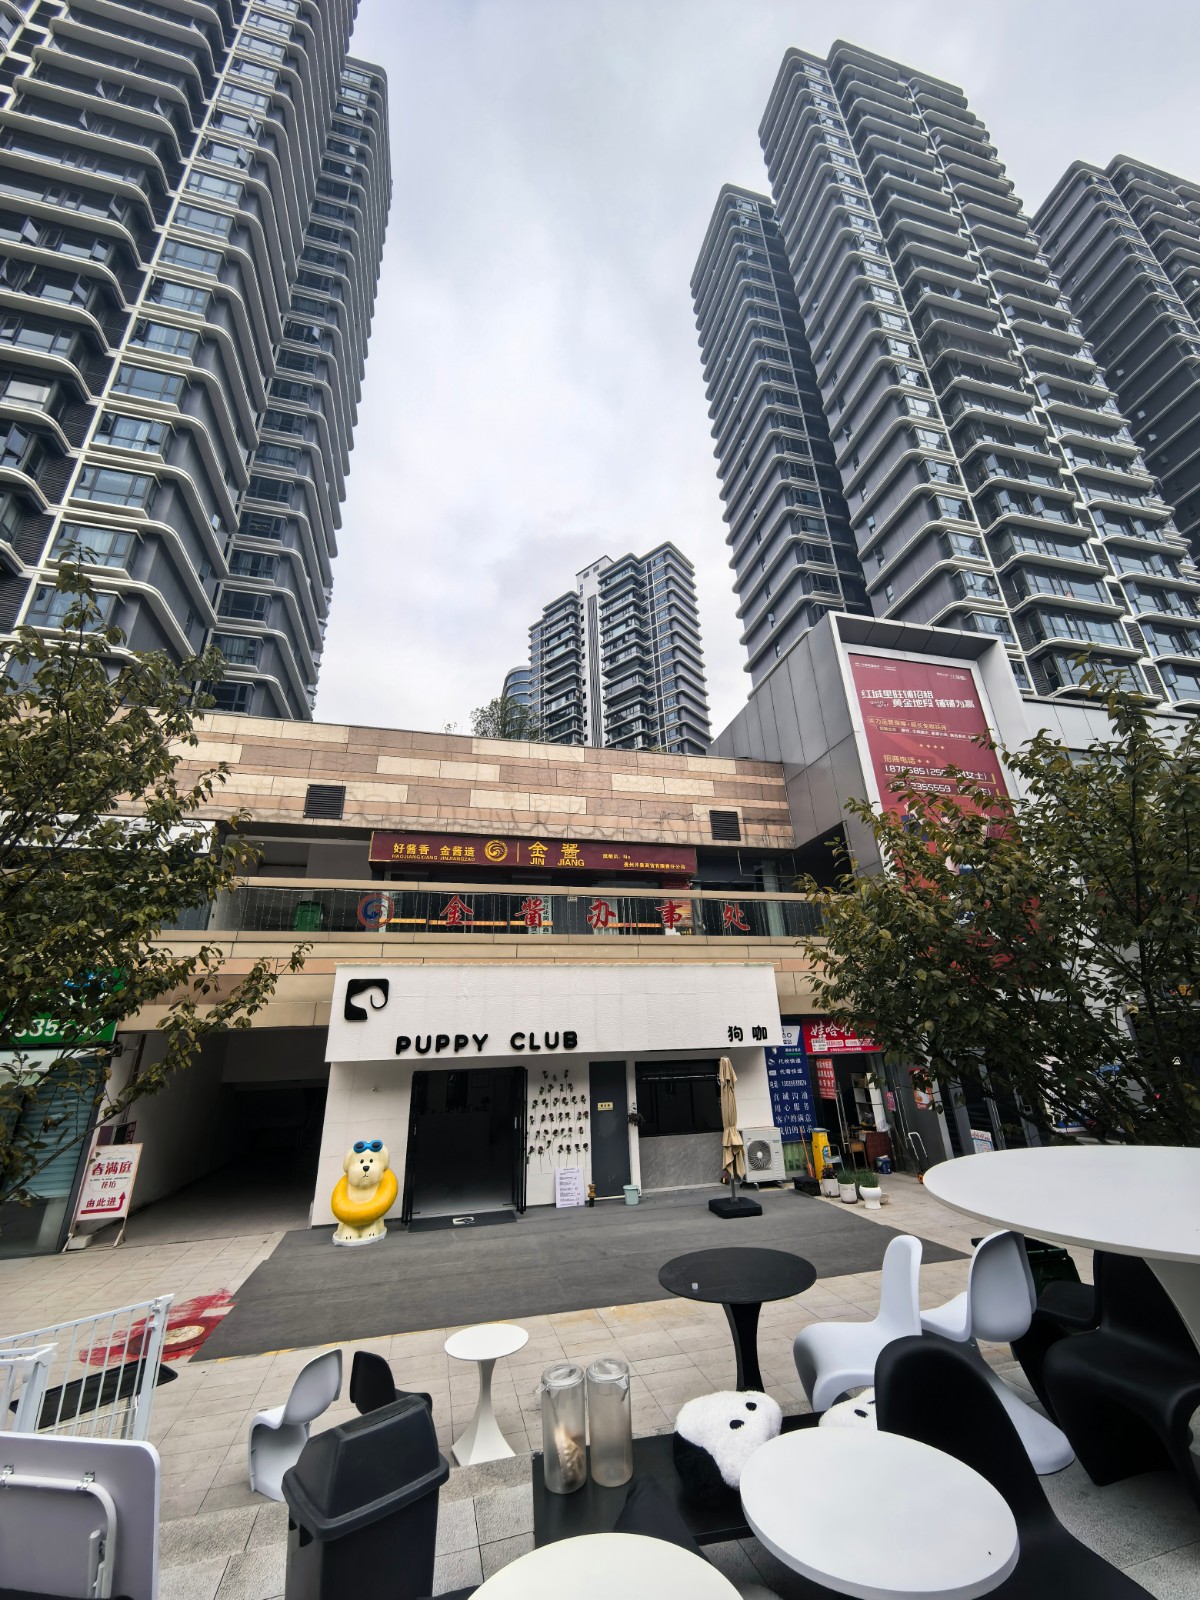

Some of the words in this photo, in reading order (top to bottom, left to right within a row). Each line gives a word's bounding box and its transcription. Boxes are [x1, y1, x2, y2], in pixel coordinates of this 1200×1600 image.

[892, 698, 934, 708] 黄金地段
[393, 843, 430, 855] 好酱香
[440, 845, 475, 857] 金酱造
[529, 858, 545, 866] JIN
[557, 858, 585, 867] JIANG
[727, 1025, 768, 1042] 狗咖
[395, 1033, 488, 1055] PUPPY
[510, 1031, 578, 1051] CLUB
[85, 1197, 117, 1208] 由此进
